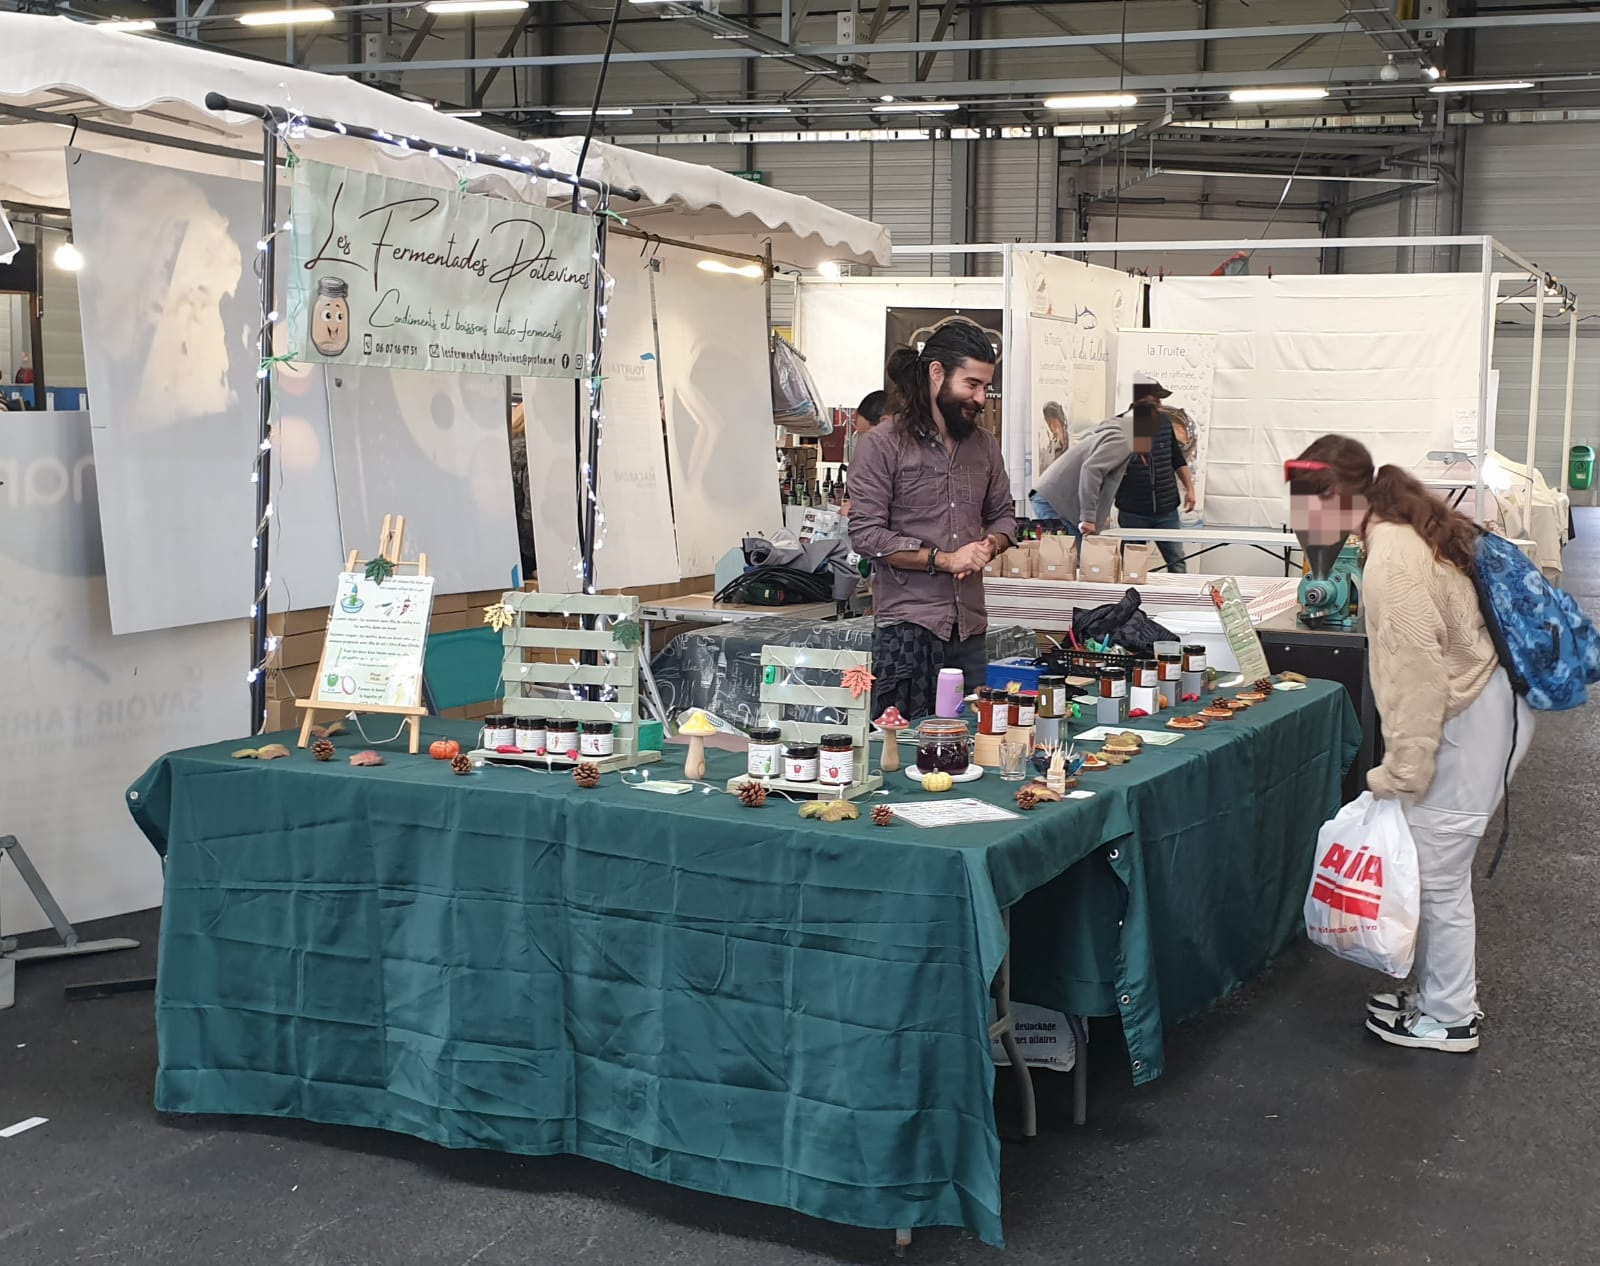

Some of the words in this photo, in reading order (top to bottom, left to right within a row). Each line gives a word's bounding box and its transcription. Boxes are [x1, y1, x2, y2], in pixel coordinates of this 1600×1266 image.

[304, 182, 369, 270] Les
[358, 197, 488, 292] Fermentades
[489, 219, 591, 313] Poitevines
[368, 288, 437, 331] Condiments
[440, 308, 451, 330] et
[455, 312, 488, 335] boissons
[1147, 344, 1155, 356] la
[1157, 344, 1186, 357] Truite
